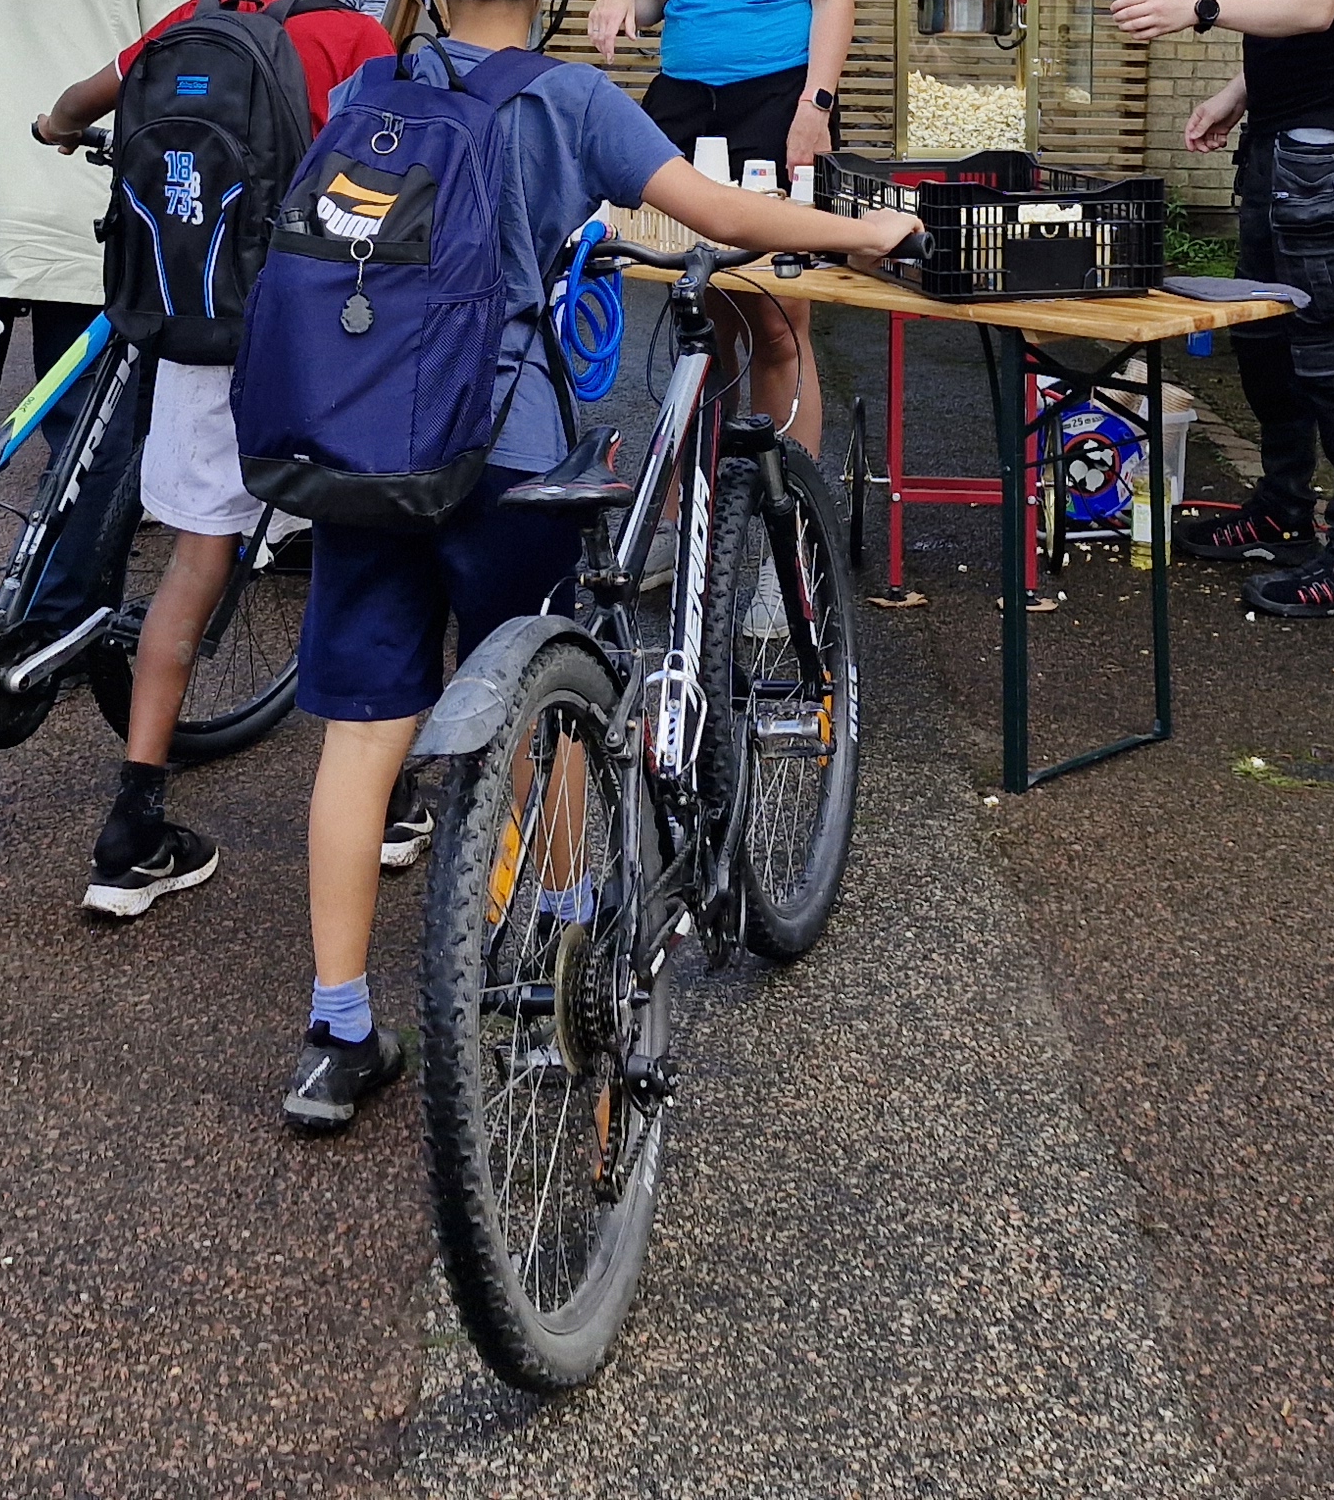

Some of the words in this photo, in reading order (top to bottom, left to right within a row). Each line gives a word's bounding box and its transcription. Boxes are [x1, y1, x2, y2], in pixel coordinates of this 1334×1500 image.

[164, 150, 194, 182] 18
[164, 185, 192, 216] 73
[58, 342, 140, 513] TREK
